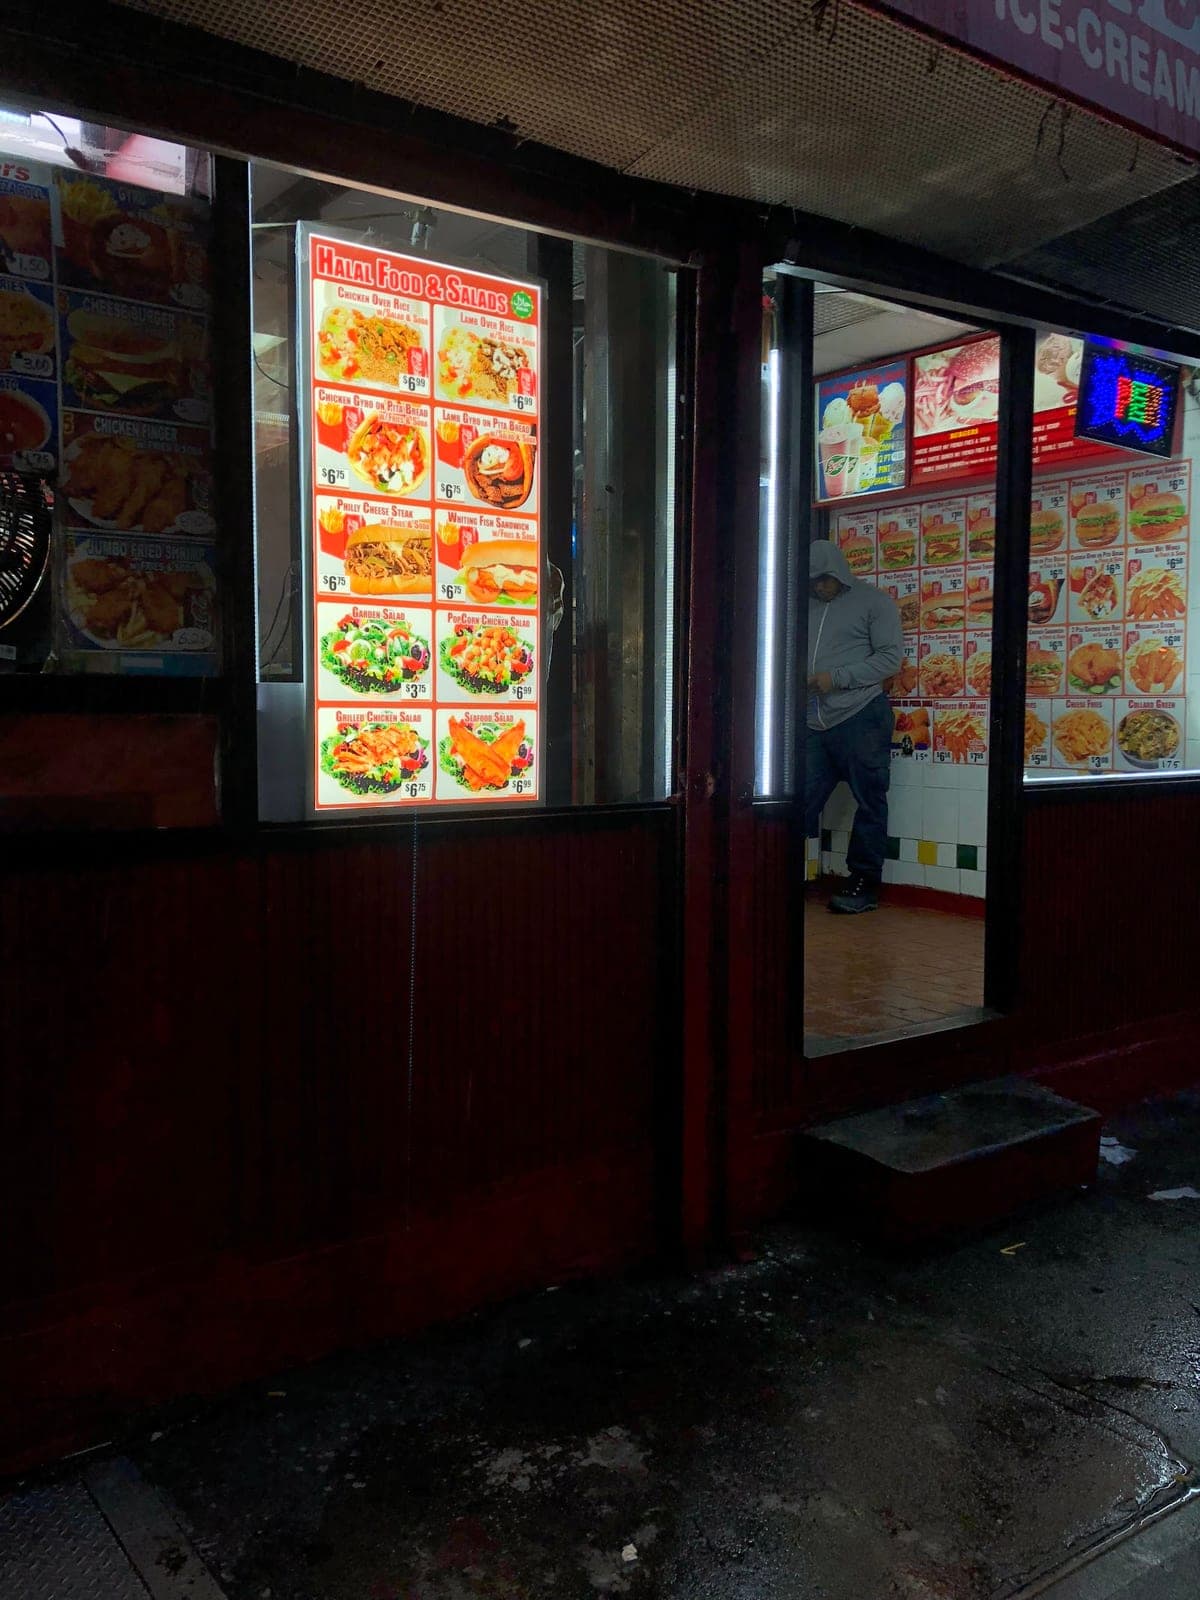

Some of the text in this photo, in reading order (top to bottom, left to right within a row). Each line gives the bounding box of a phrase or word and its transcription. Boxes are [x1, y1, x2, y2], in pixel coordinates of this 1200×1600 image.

[316, 245, 509, 315] HALAL FOOD & SALADS
